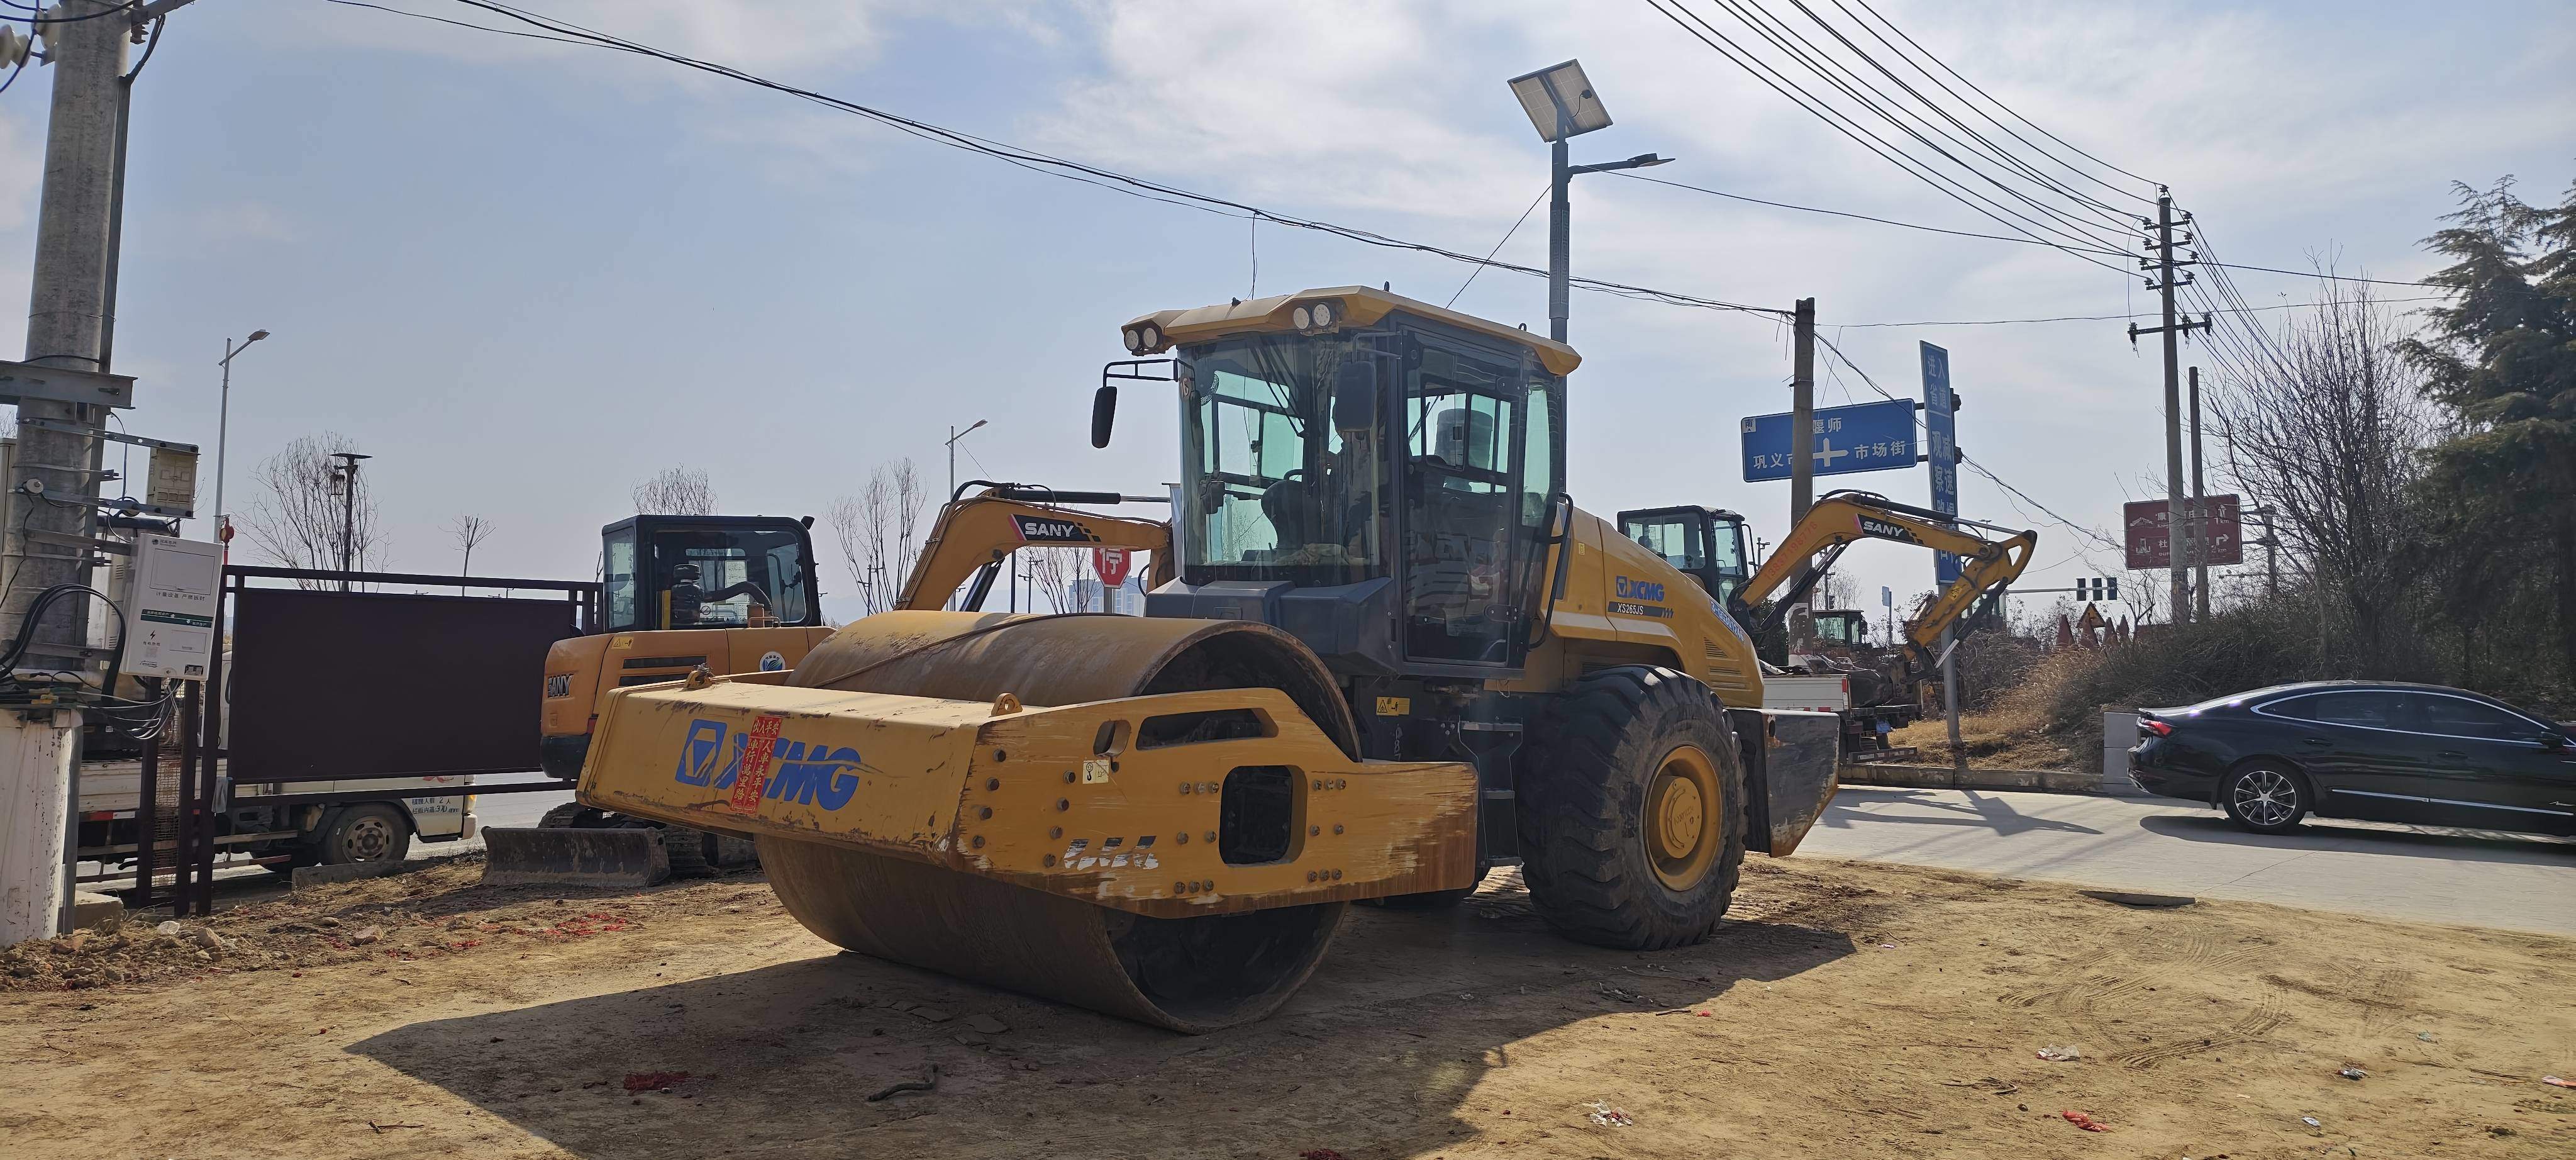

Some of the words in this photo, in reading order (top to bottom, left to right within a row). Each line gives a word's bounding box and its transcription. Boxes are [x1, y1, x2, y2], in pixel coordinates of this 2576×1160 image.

[1745, 418, 1753, 428] 南
[1854, 440, 1906, 460] 市场街
[1024, 522, 1074, 537] SANY
[1863, 521, 1904, 537] SANY
[1628, 579, 1665, 602] XCMG
[1617, 603, 1643, 615] XS265JS
[548, 674, 574, 698] SANY
